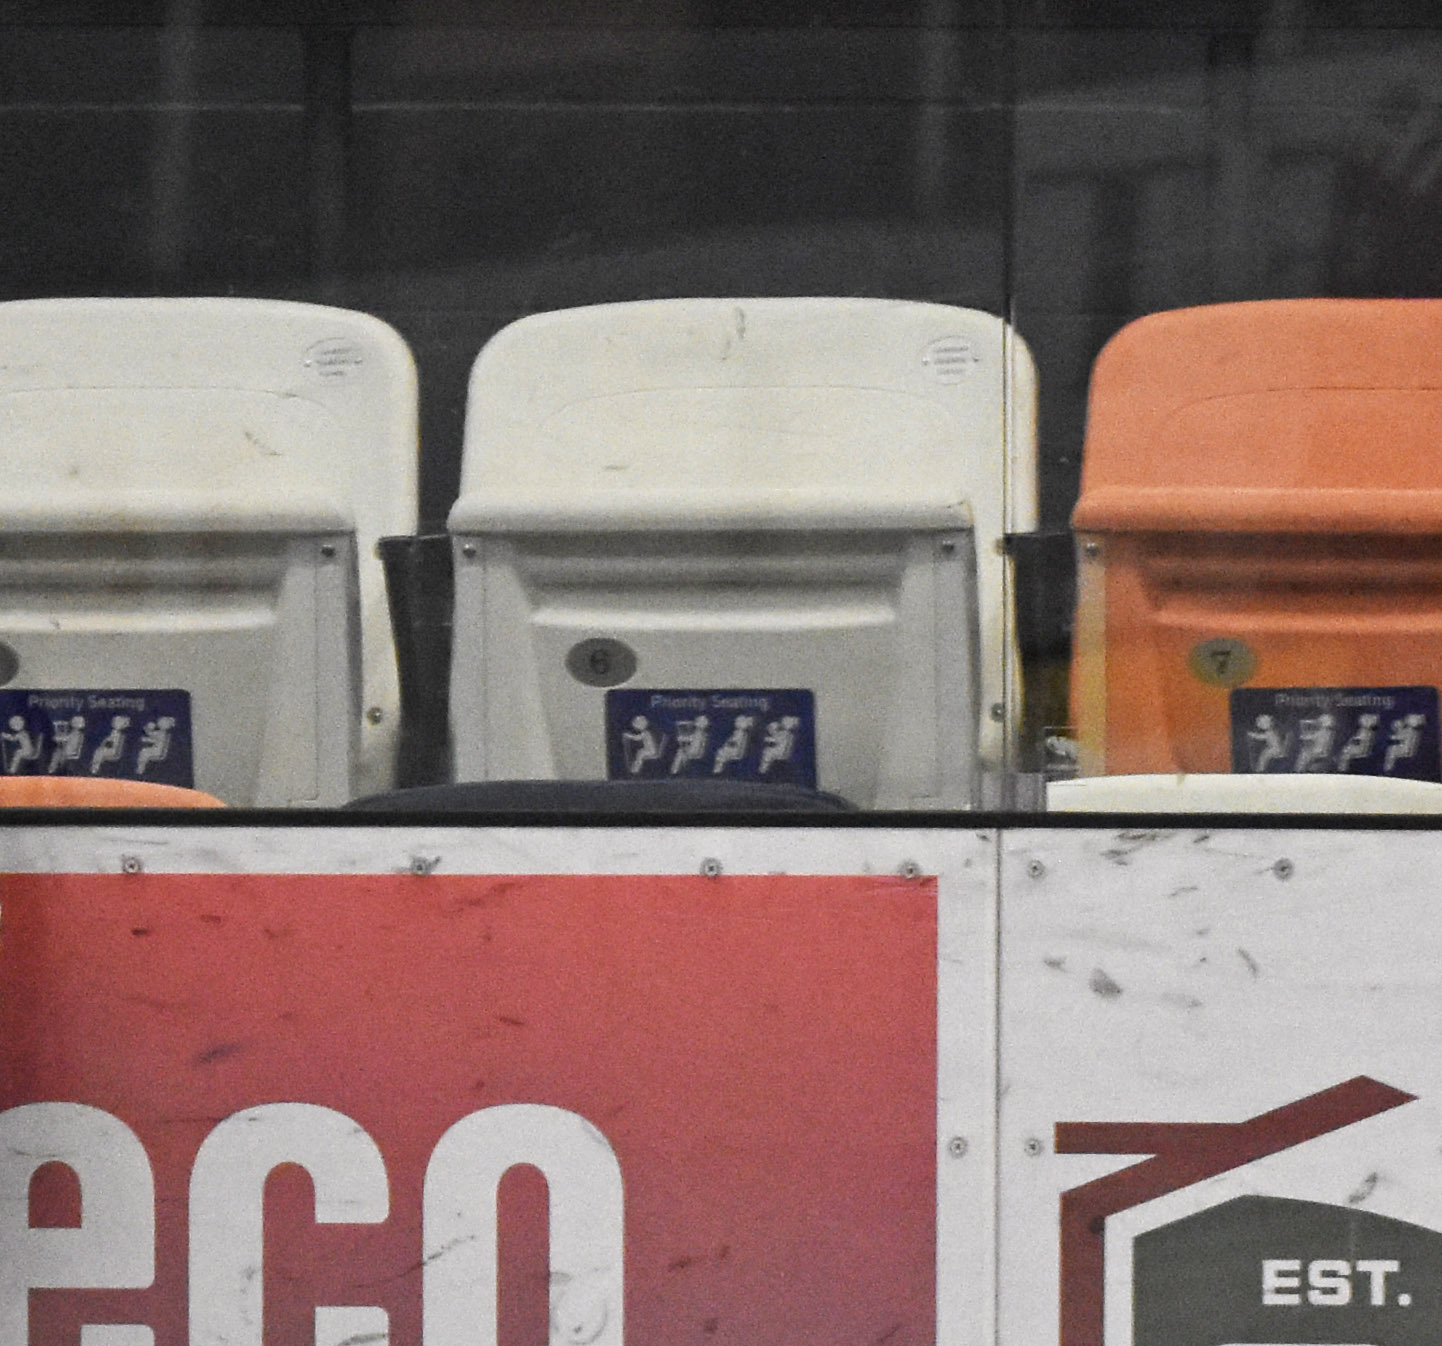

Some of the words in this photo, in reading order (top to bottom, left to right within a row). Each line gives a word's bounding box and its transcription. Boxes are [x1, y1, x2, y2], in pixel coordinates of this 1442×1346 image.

[1211, 650, 1232, 674] 7
[28, 694, 84, 712] Priority
[88, 694, 146, 712] Seating
[651, 695, 707, 711] Priority
[711, 695, 769, 712] Seating
[1275, 694, 1332, 709] Priority
[1335, 694, 1395, 710] Seating
[1261, 1259, 1412, 1306] EST.
